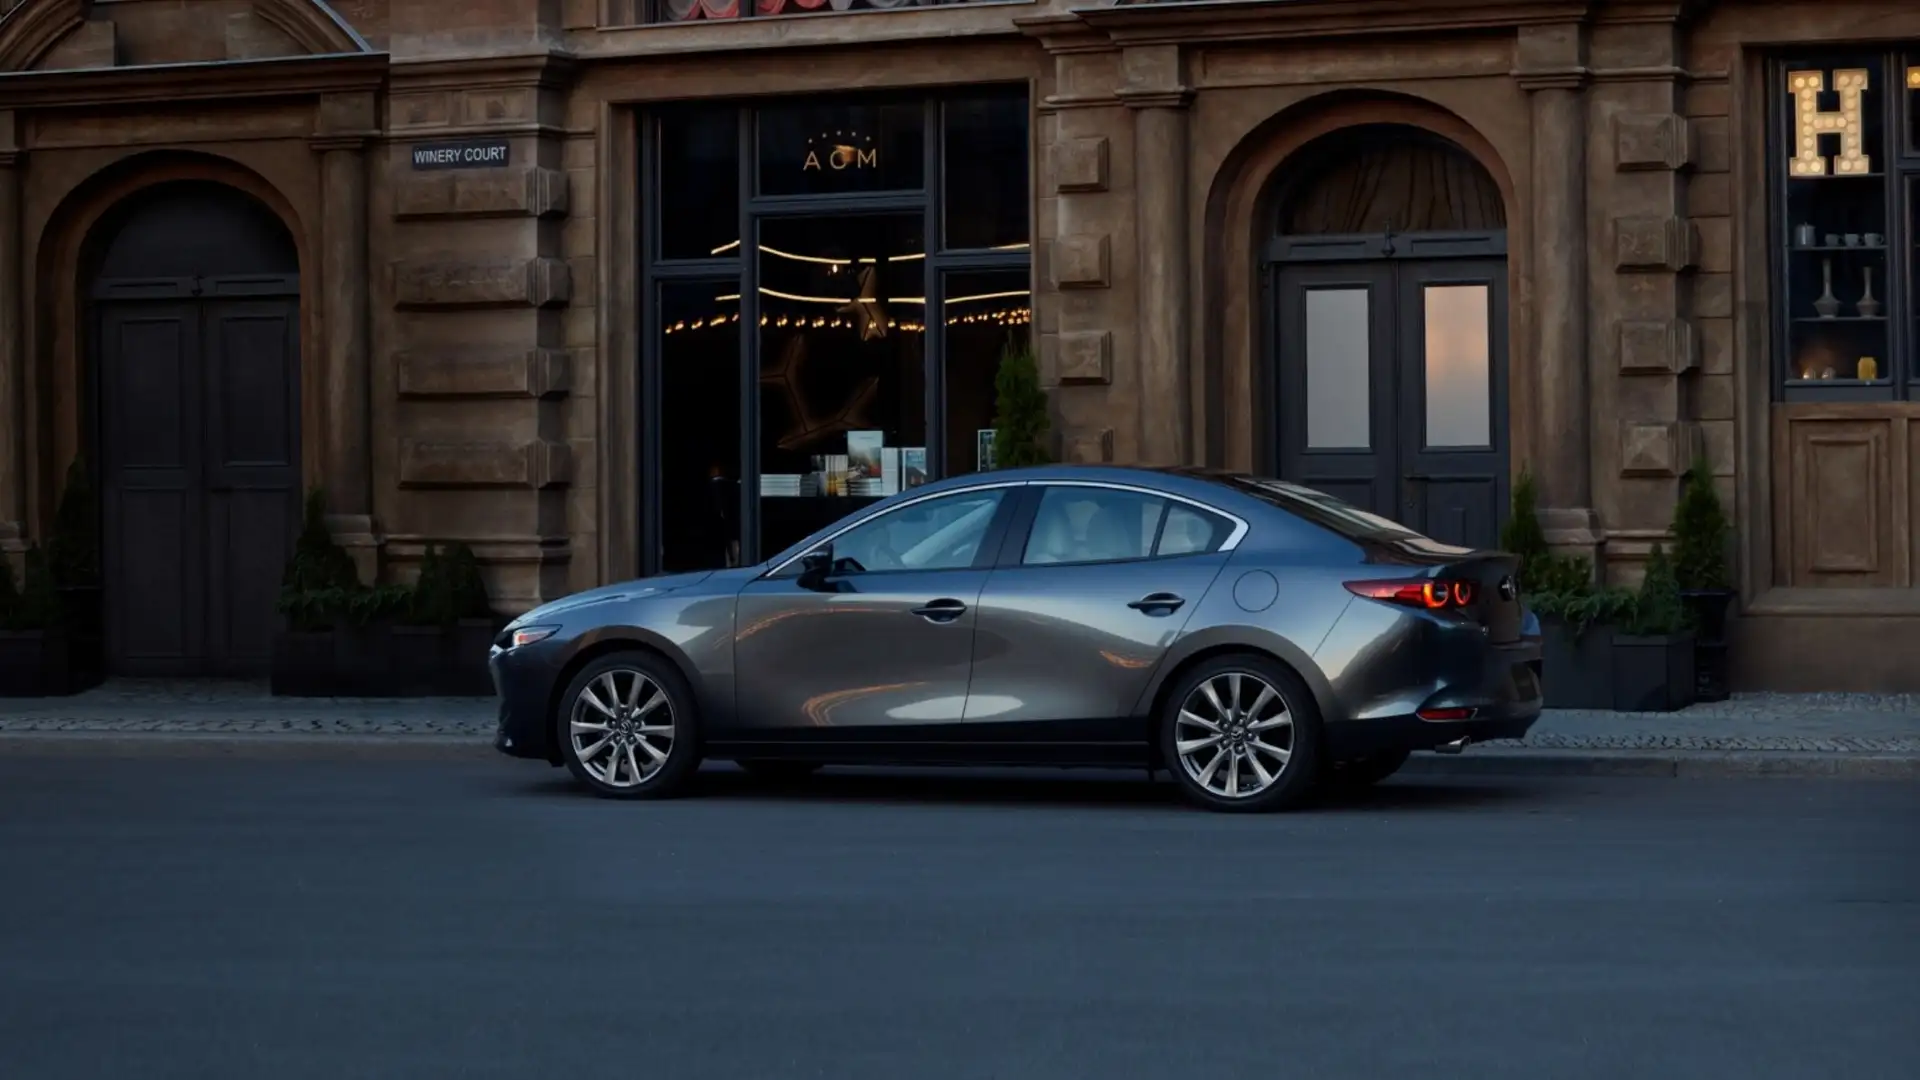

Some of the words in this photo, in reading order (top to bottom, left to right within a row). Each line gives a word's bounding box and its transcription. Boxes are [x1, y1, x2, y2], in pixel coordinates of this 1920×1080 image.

[1788, 68, 1869, 176] H
[414, 149, 461, 164] WINERY
[464, 146, 506, 162] COURT
